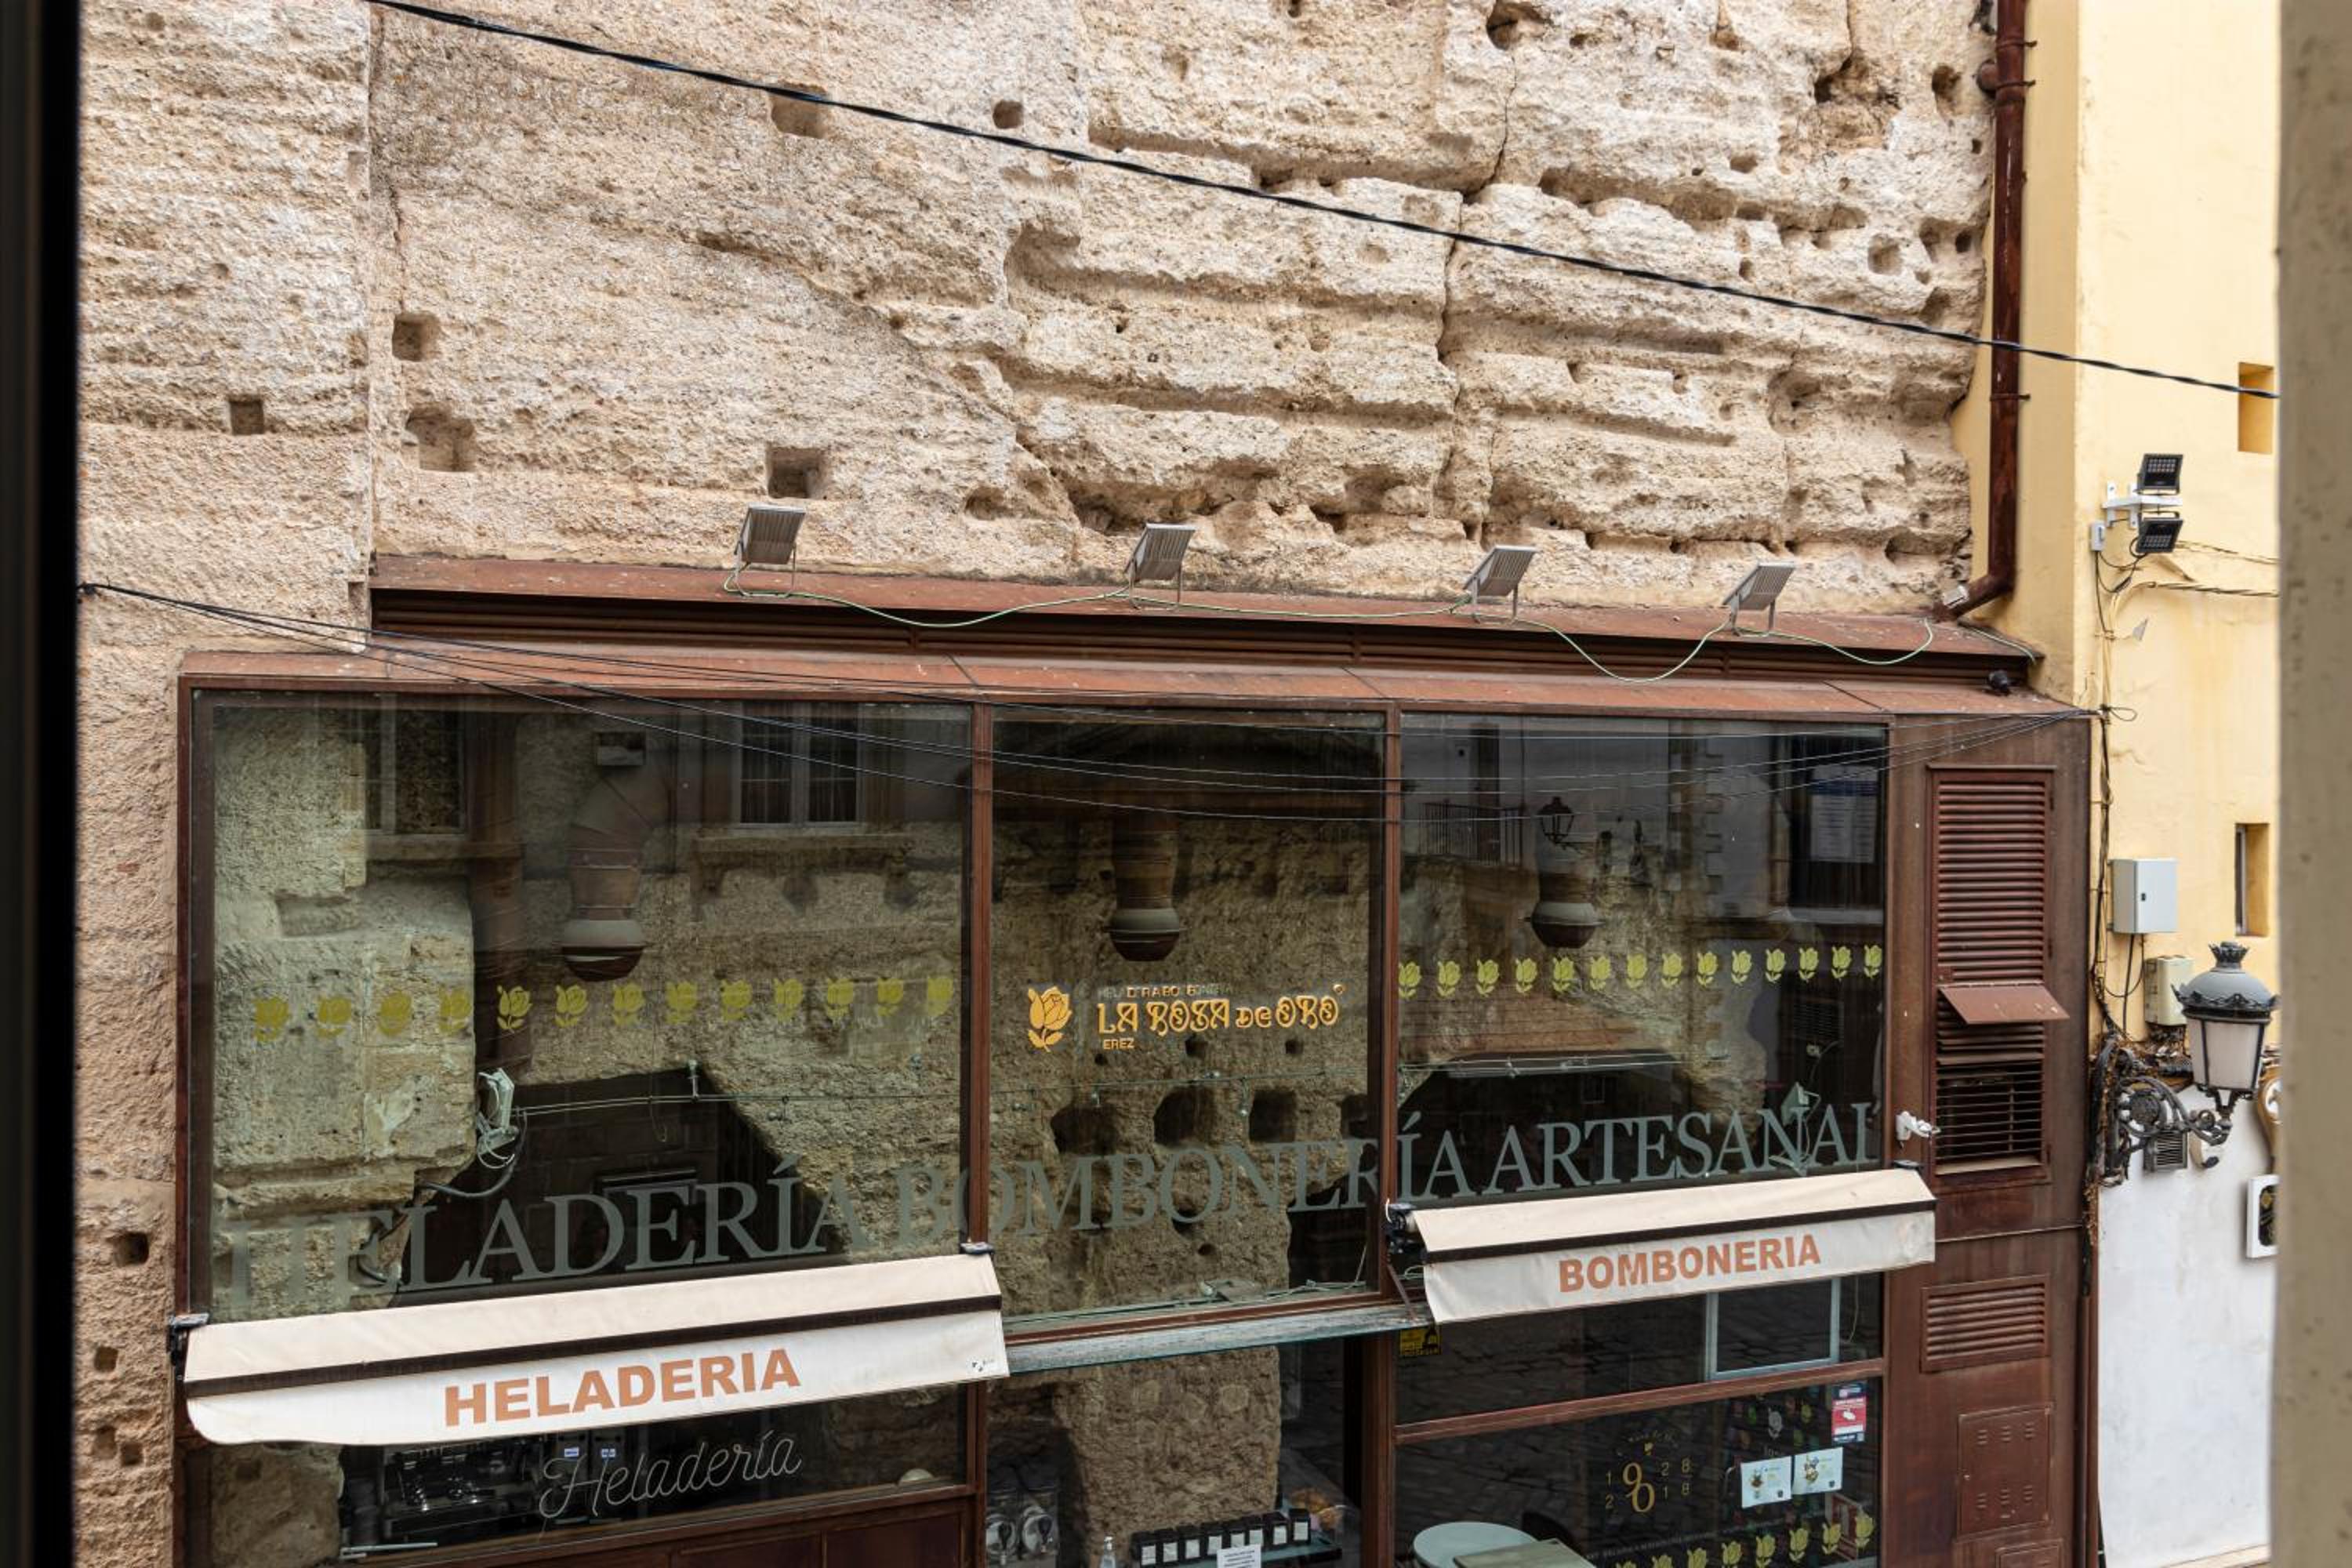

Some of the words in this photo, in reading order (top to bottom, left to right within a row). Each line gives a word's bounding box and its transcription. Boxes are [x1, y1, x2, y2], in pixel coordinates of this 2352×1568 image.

[1098, 1002, 1138, 1034] LA
[1146, 999, 1230, 1036] ROSA
[1276, 996, 1339, 1028] ORO
[1480, 1102, 1880, 1195] ARTESANAL
[1559, 1234, 1820, 1293] BOMBONERIA
[445, 1349, 800, 1426] HELADERIA
[539, 1430, 802, 1518] Heladería
